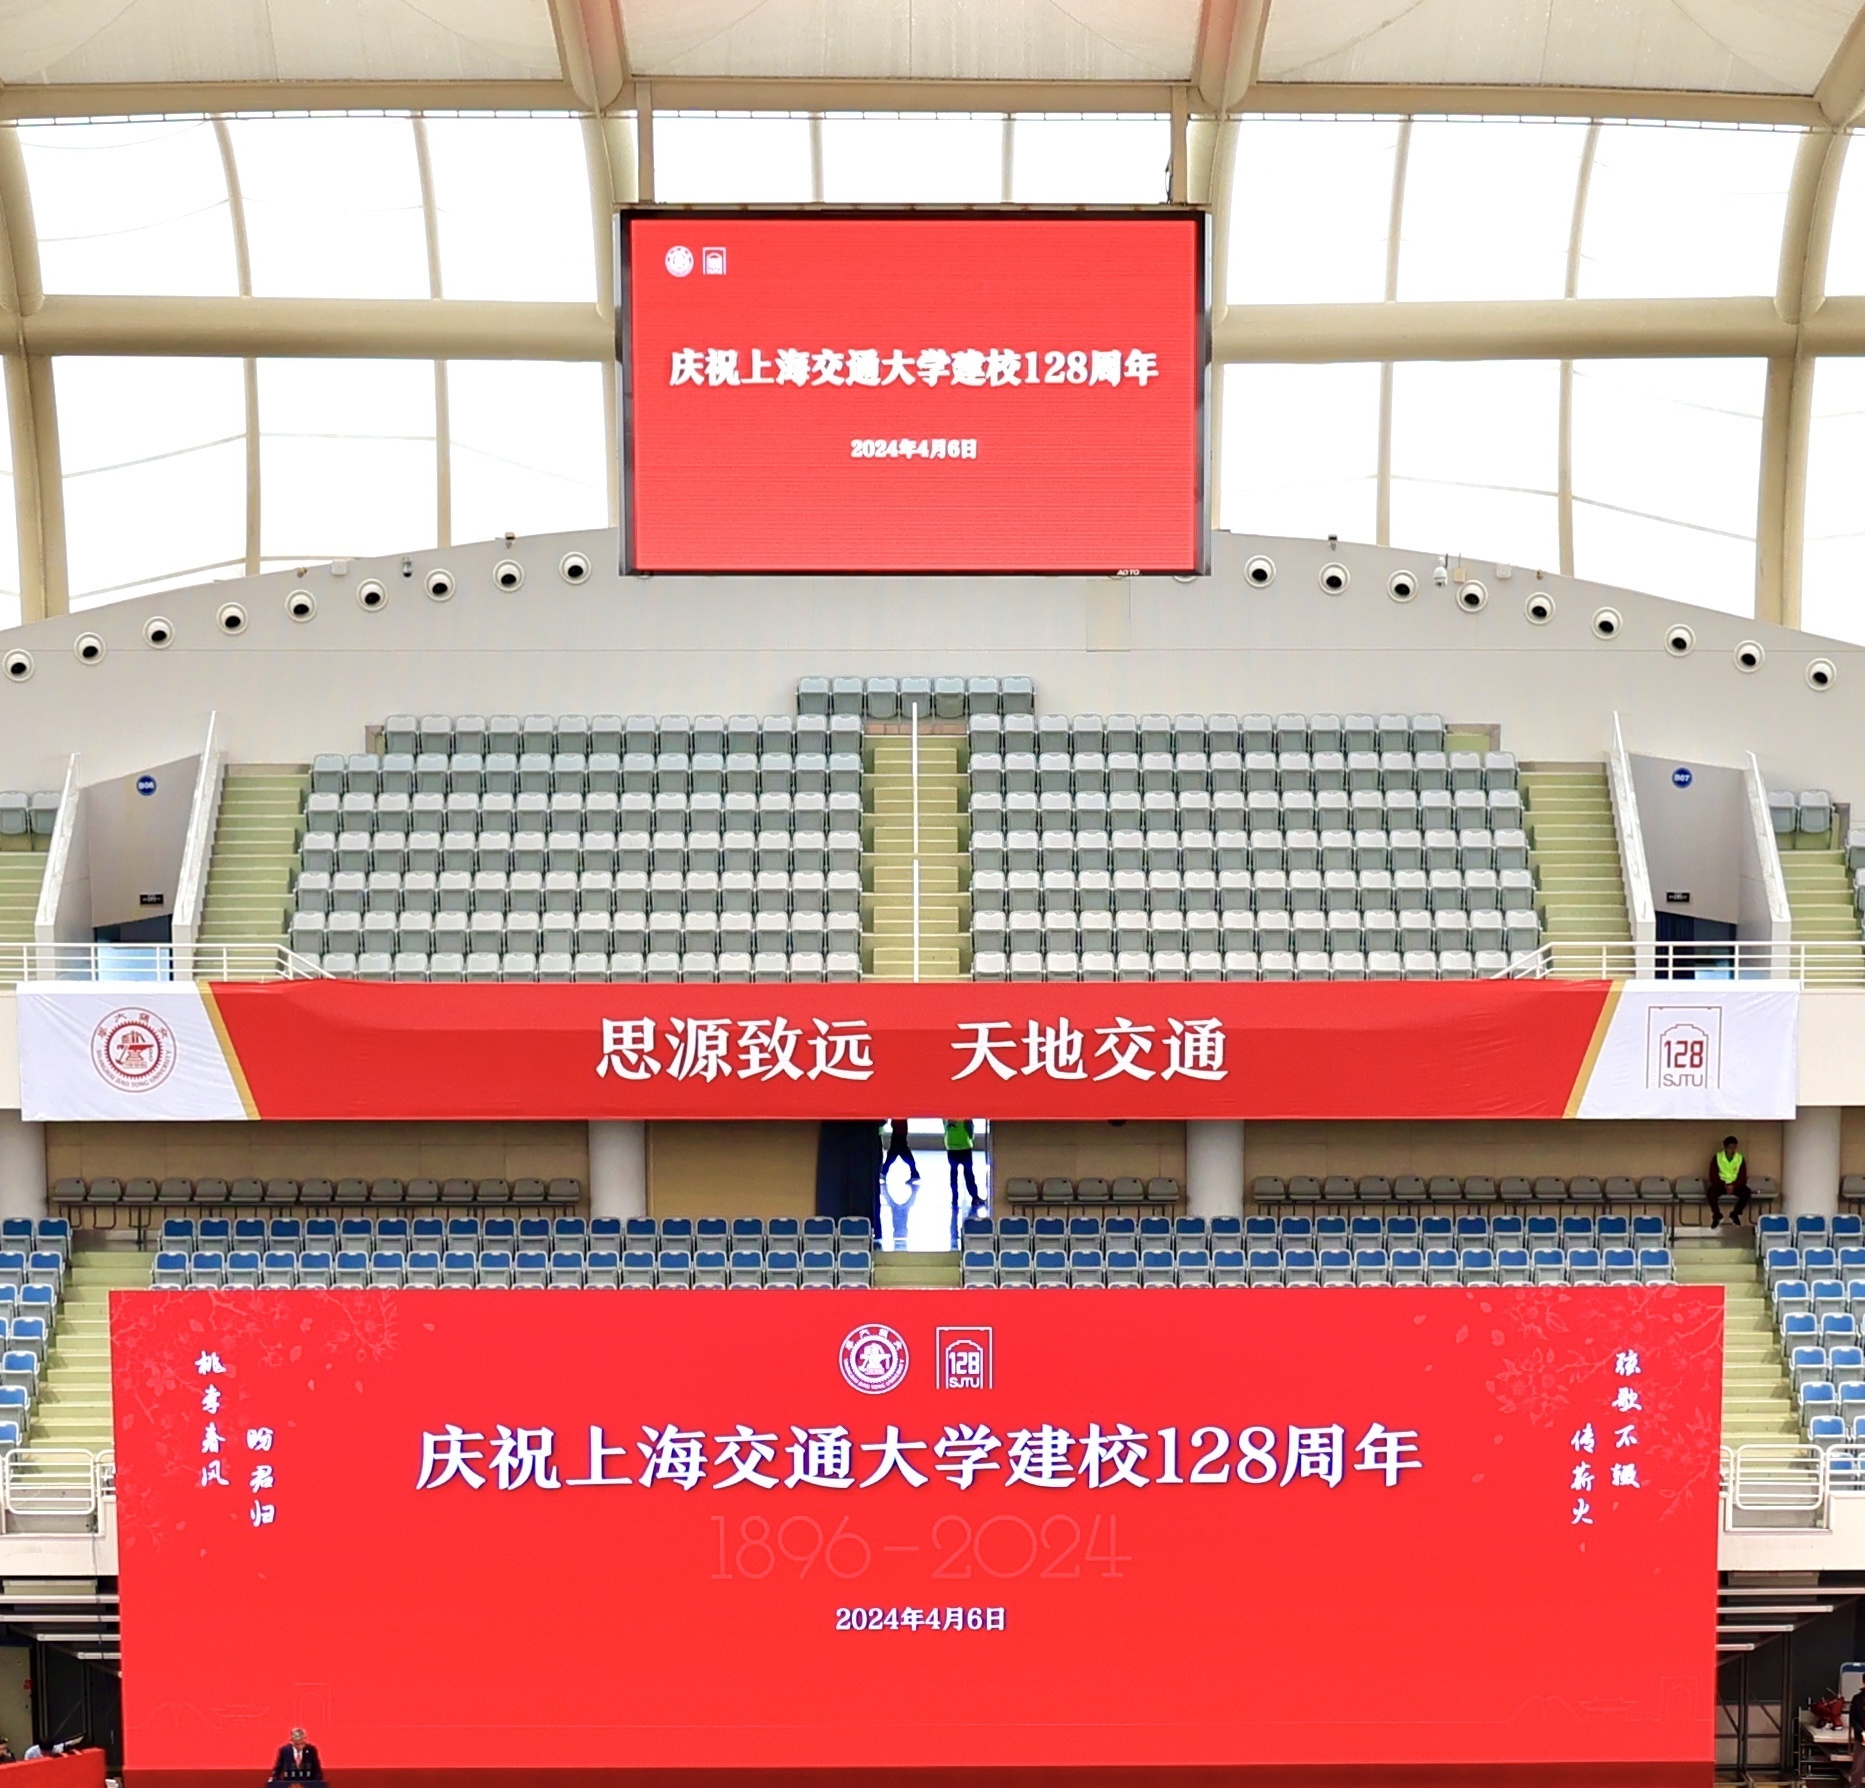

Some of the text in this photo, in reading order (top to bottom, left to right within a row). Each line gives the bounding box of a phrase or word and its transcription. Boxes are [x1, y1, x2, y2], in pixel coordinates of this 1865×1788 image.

[670, 347, 1159, 387] 庆祝上海交通大学建校128周年
[851, 438, 978, 460] 2024年4月6日
[596, 1016, 1229, 1082] 思源致远 天地交通
[1664, 1040, 1704, 1068] 128
[1663, 1073, 1703, 1087] SJTU
[949, 1351, 980, 1375] 128
[949, 1377, 980, 1388] SJTU
[195, 1350, 230, 1487] 桃李春风
[1610, 1349, 1643, 1489] 弦歌不辍
[416, 1422, 1424, 1491] 庆祝上海交通大学建校128周年
[246, 1427, 276, 1527] 盼君归
[836, 1606, 1006, 1632] 2024年4月6日
